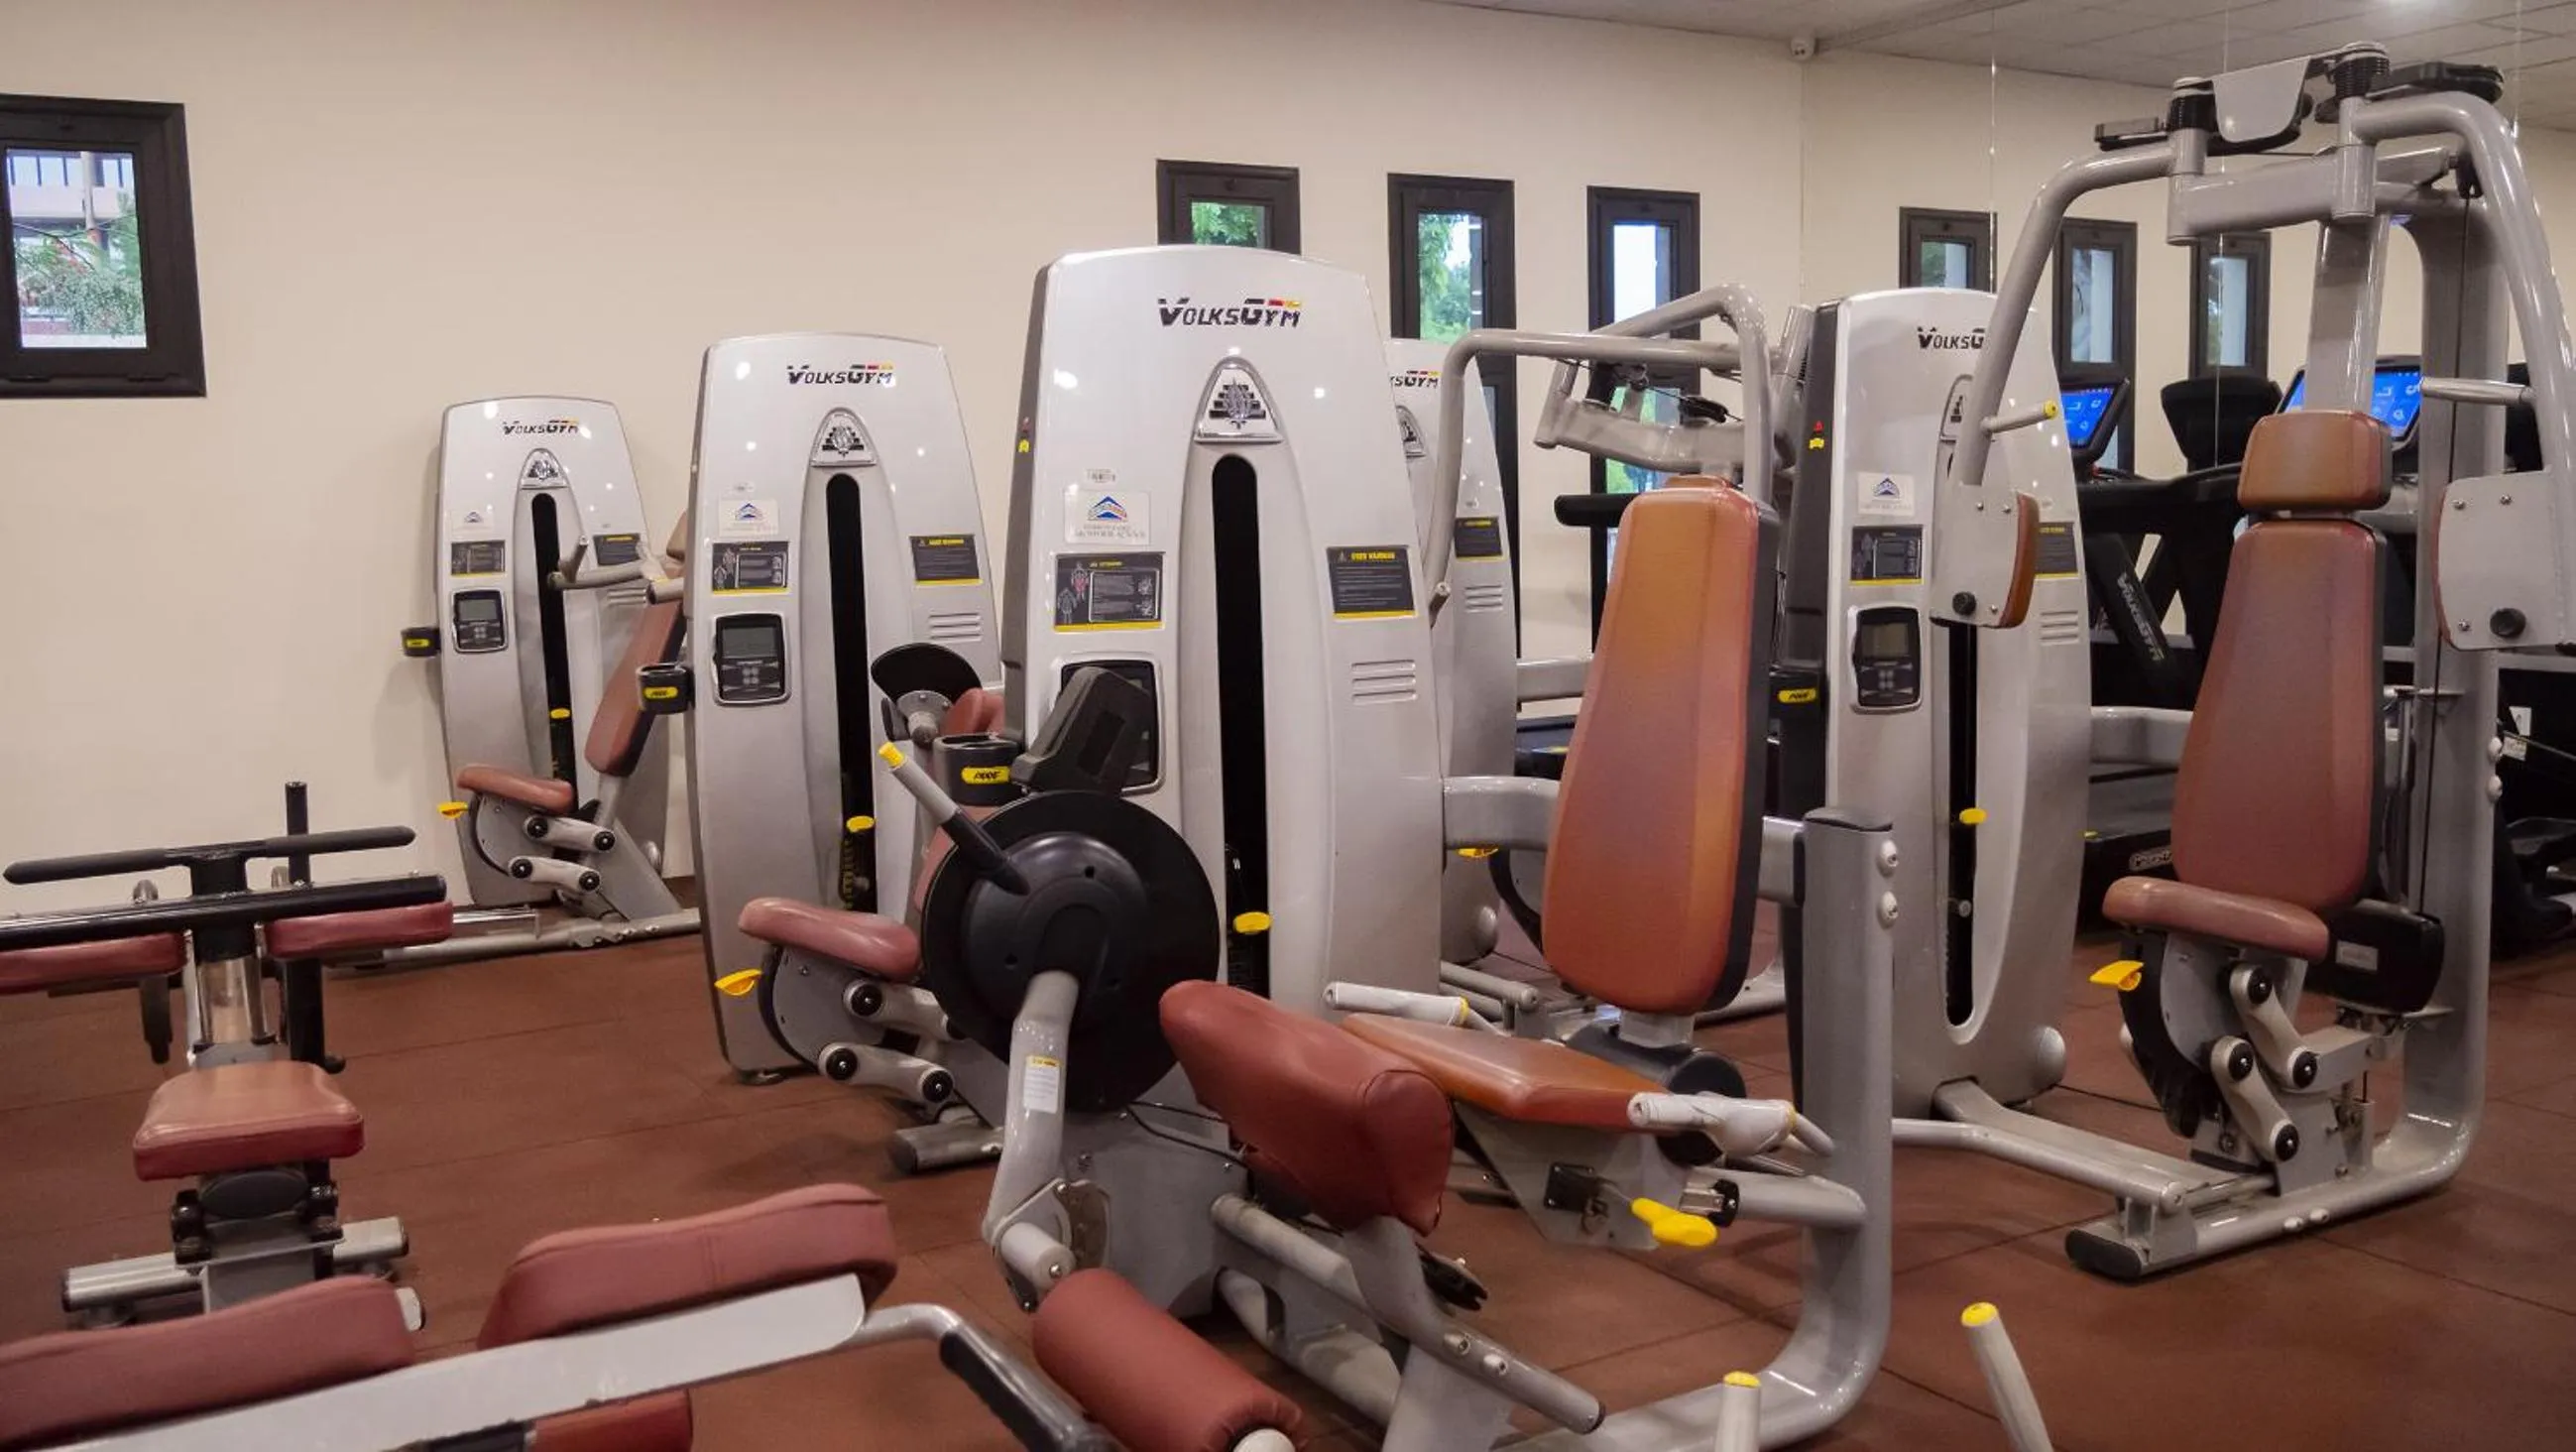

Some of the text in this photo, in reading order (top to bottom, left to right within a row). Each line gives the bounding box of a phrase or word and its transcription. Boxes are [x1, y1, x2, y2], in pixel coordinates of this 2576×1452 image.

[1157, 298, 1301, 327] VOLKSGYM
[1917, 326, 1985, 349] VOLKSG
[786, 363, 894, 385] VOLKSGYM
[1390, 370, 1440, 388] SGYM
